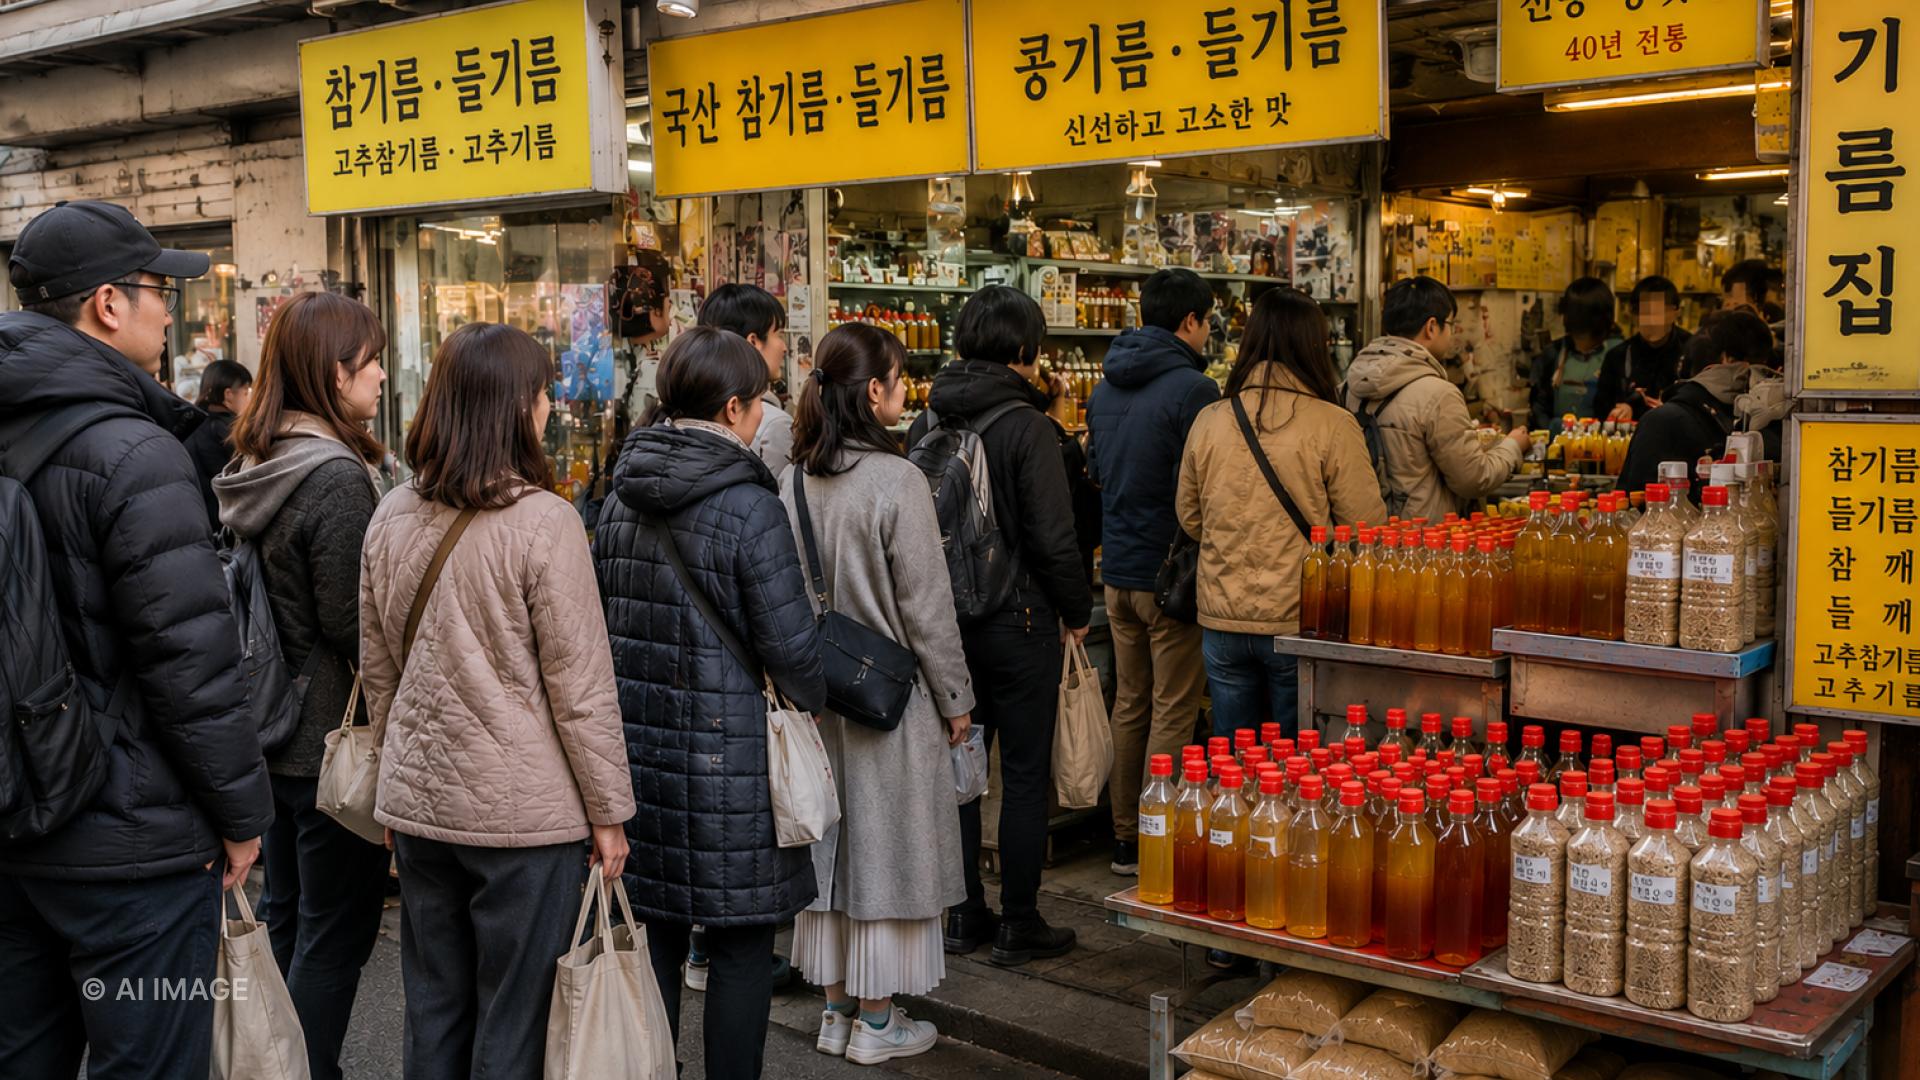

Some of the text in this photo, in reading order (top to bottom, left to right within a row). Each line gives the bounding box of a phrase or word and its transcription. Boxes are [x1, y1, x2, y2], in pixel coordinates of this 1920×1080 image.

[1565, 24, 1687, 61] 40년 전통
[662, 82, 720, 147] 국산
[1065, 93, 1291, 146] 신선하고 고소한 맛
[1823, 17, 1906, 336] 기름집
[1829, 446, 1920, 483] 참기름
[1828, 497, 1918, 534] 들기름
